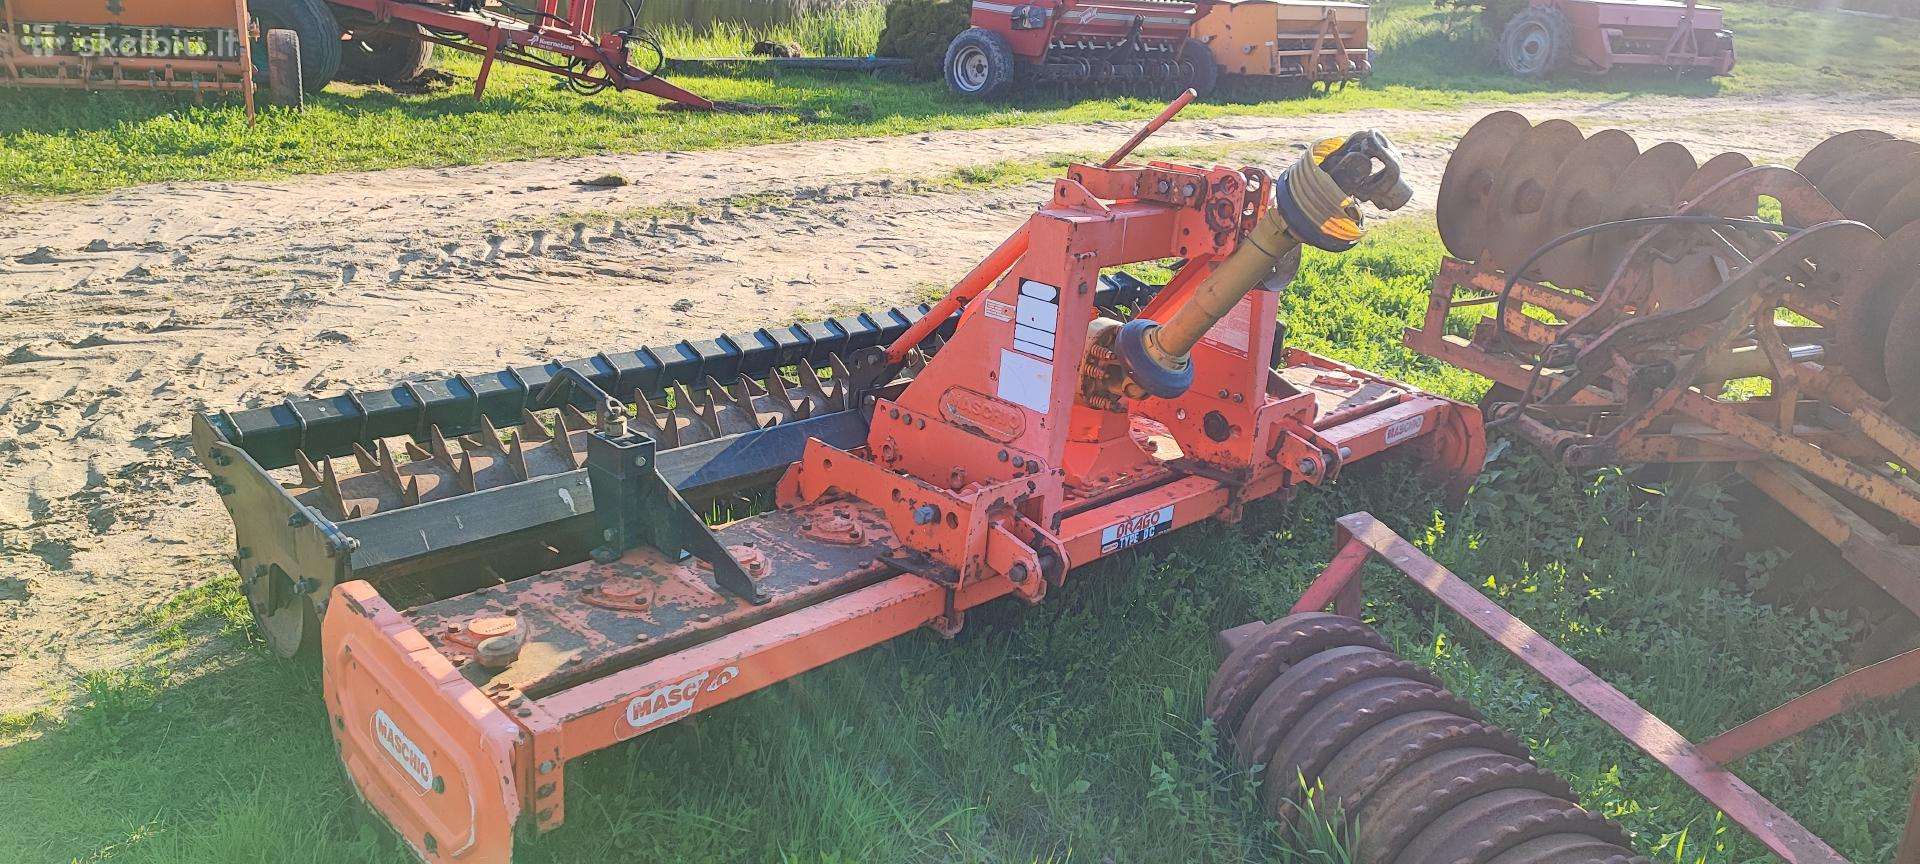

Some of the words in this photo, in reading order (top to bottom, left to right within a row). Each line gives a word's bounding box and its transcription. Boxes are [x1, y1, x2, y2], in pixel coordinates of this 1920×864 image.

[1116, 511, 1160, 539] DRAGO
[1120, 532, 1139, 548] TYPE
[632, 671, 733, 720] MASCO
[378, 718, 429, 783] MASCHIO
